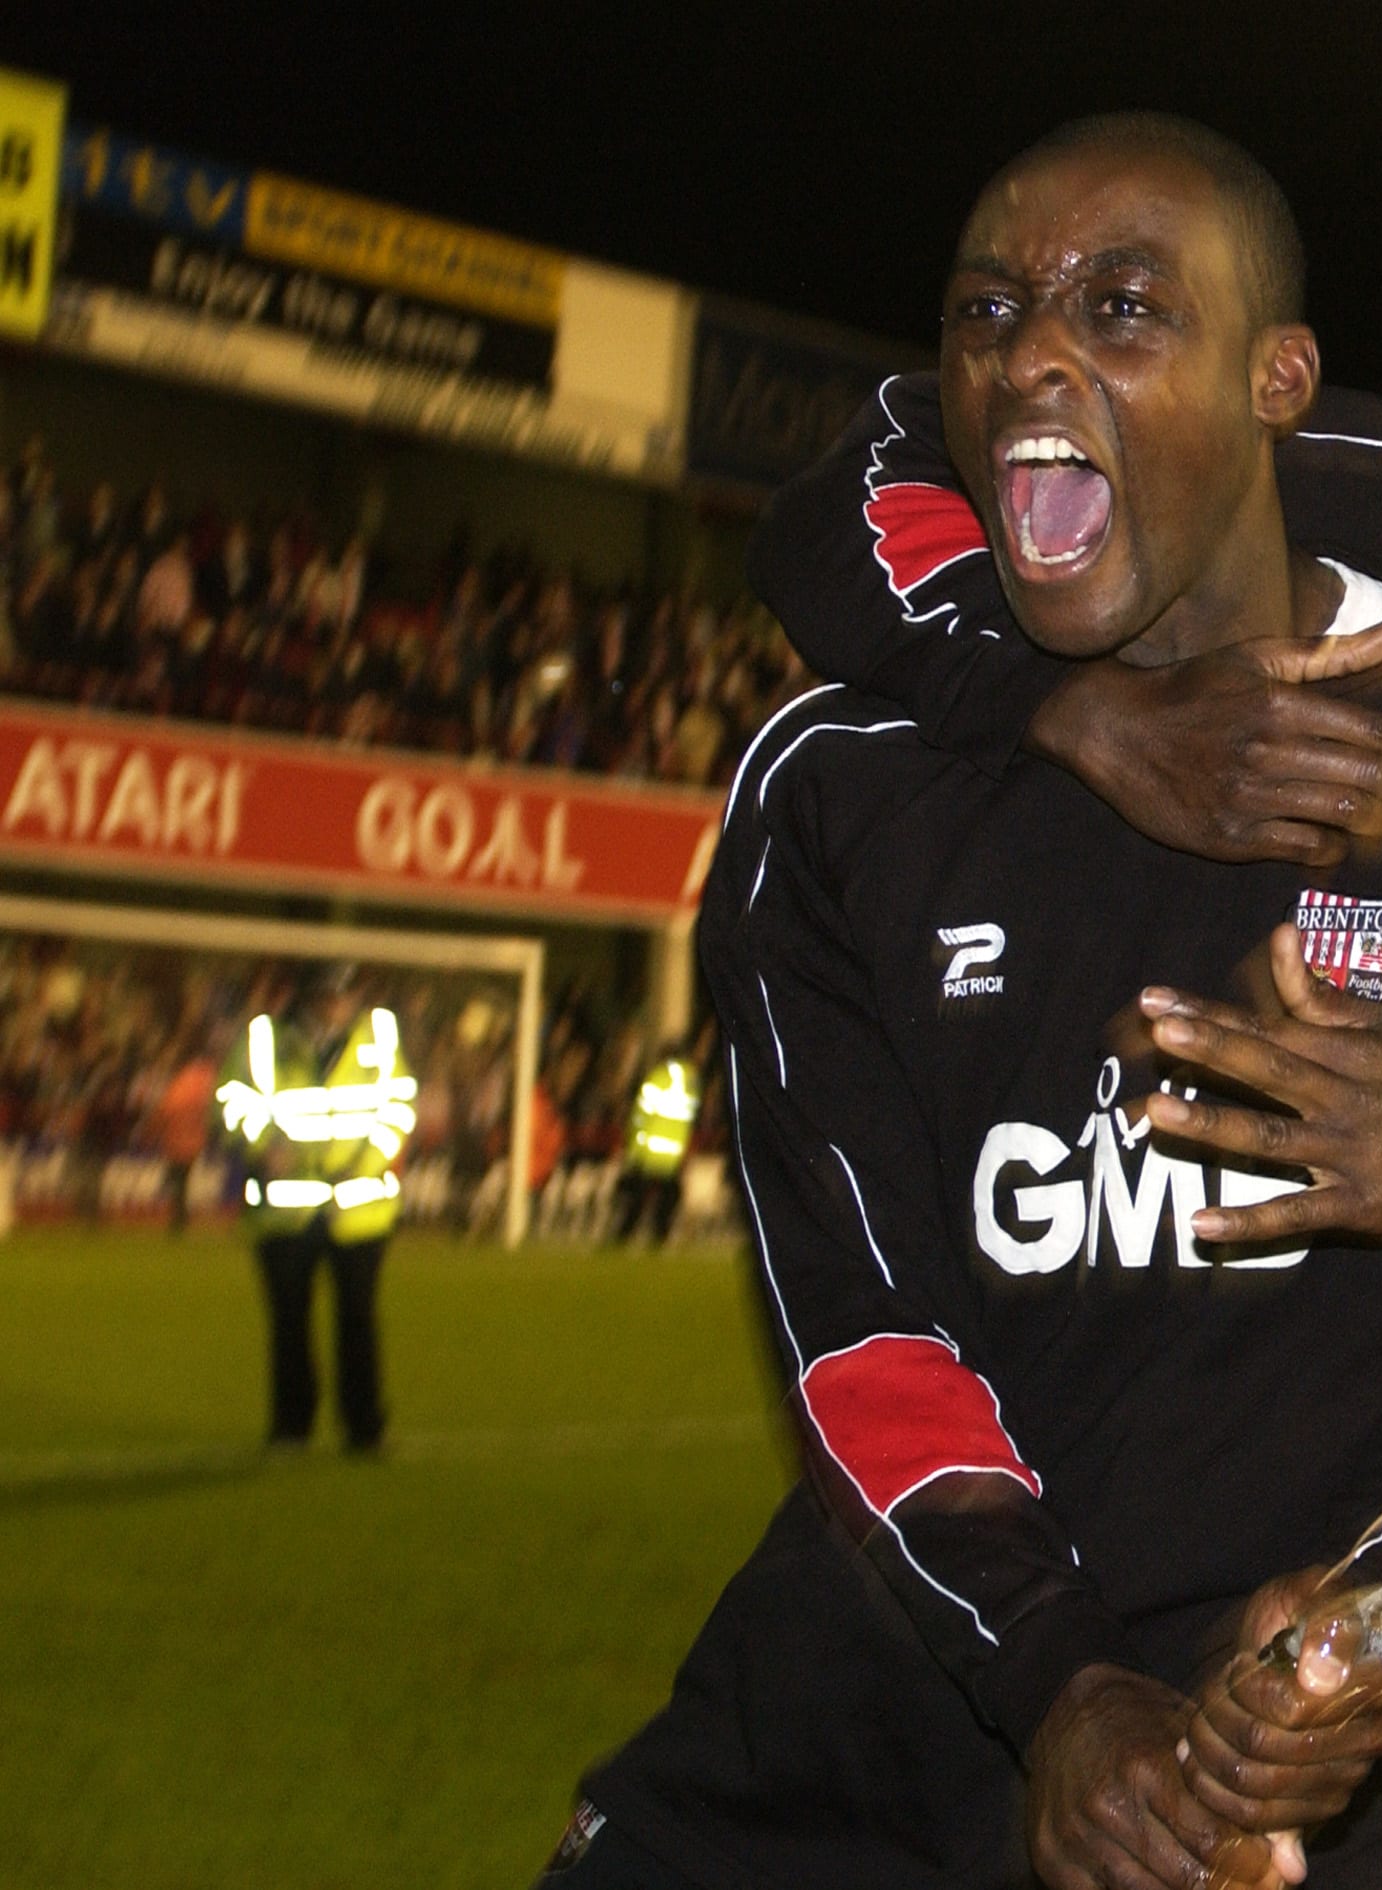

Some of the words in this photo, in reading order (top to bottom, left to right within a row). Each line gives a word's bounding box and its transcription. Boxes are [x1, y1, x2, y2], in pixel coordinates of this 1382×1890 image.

[149, 233, 275, 328] Enjoy
[281, 268, 360, 345] the
[362, 290, 485, 368] Game
[3, 738, 243, 856] ATARI
[356, 778, 586, 892] GOAL
